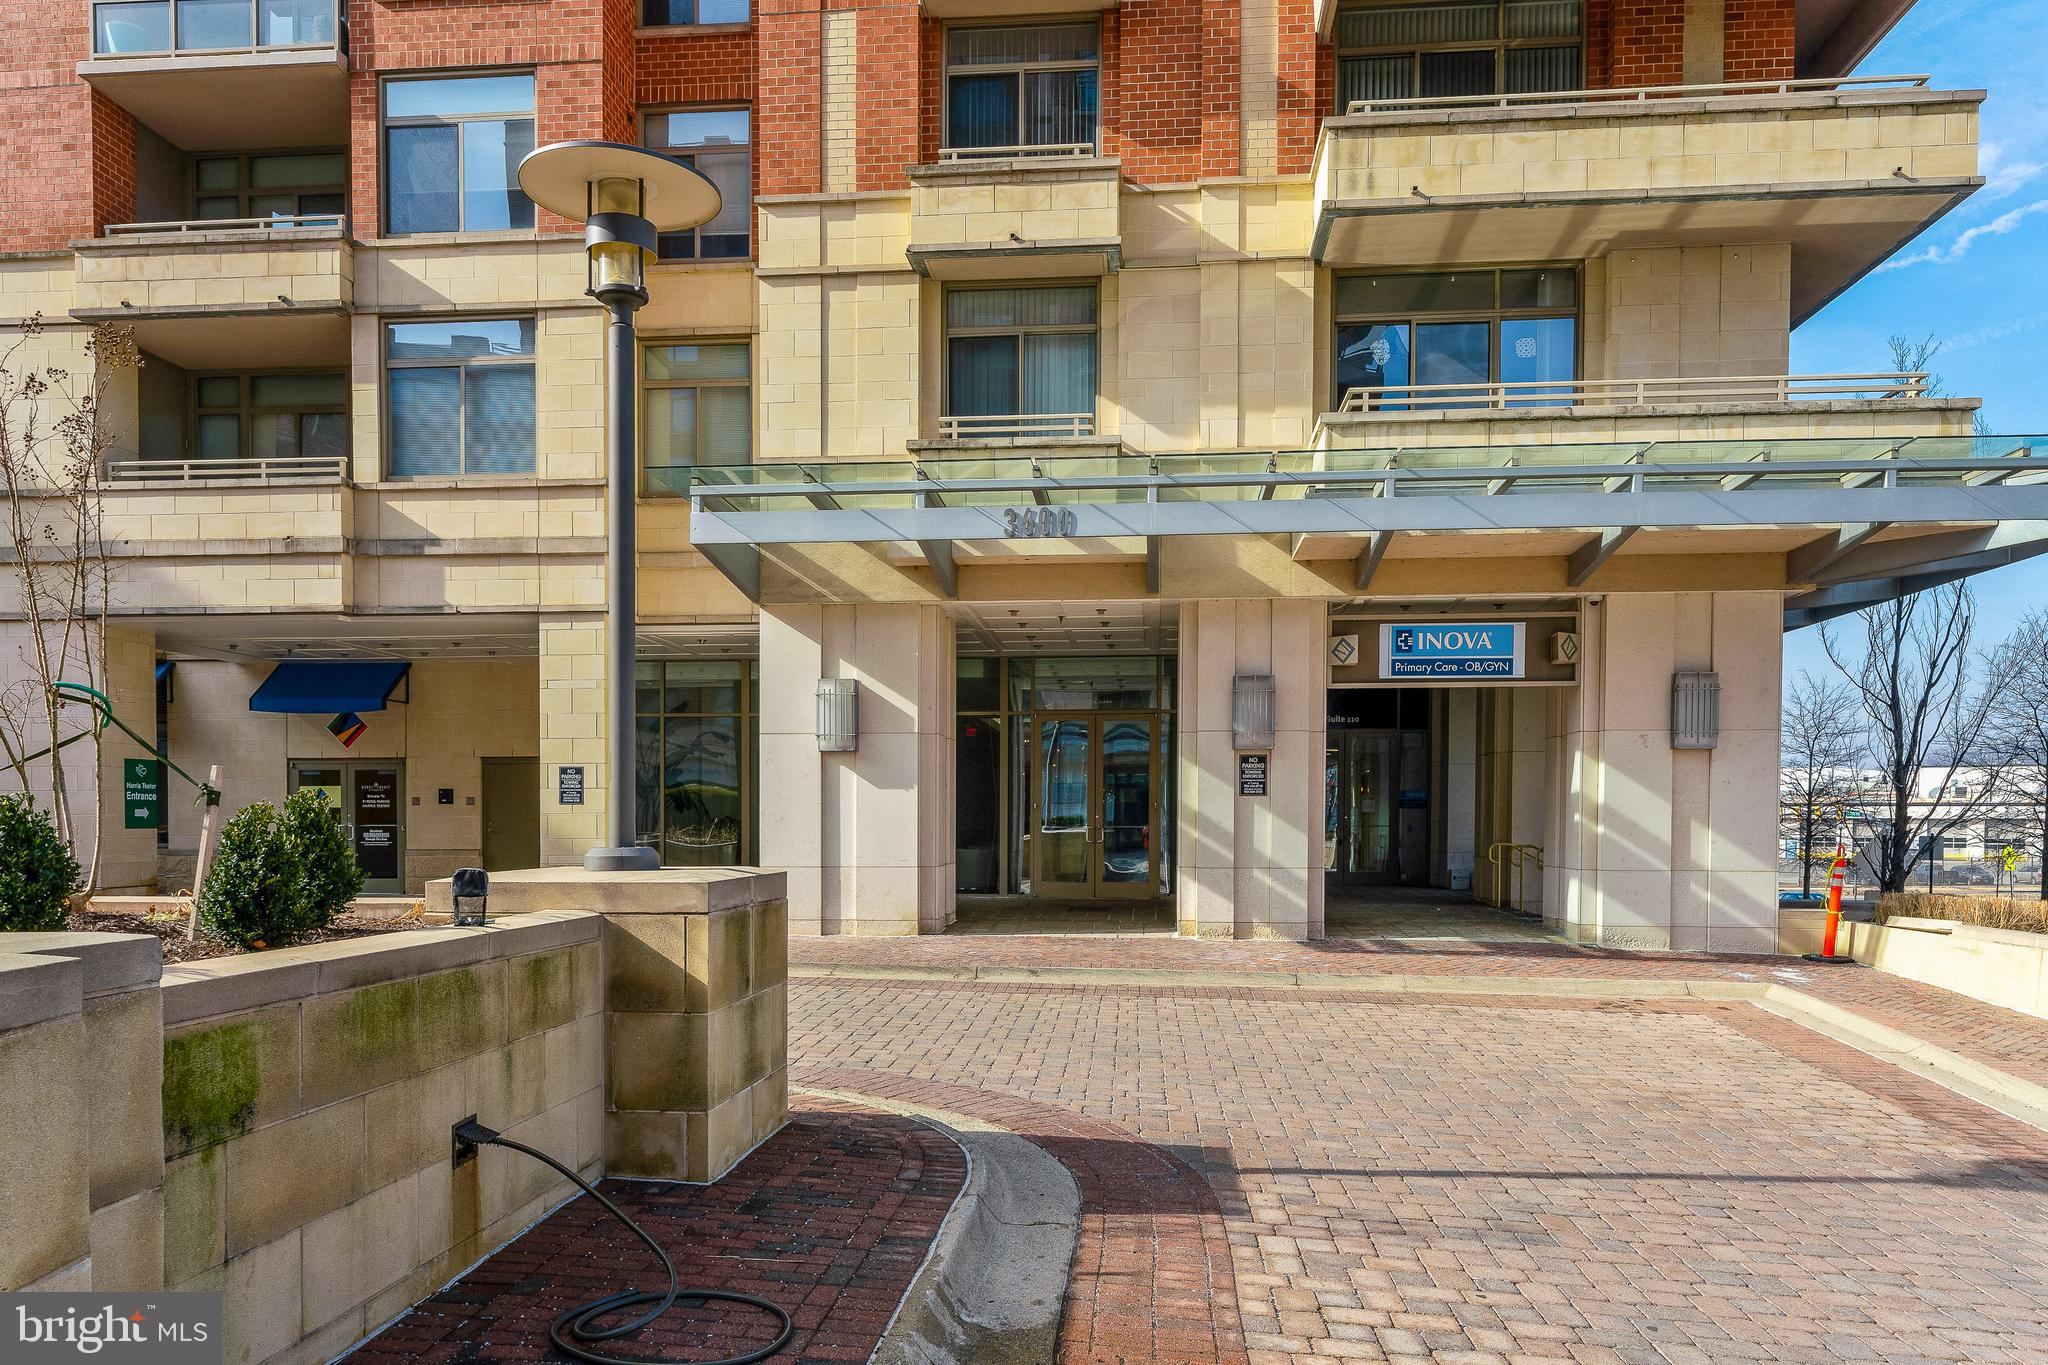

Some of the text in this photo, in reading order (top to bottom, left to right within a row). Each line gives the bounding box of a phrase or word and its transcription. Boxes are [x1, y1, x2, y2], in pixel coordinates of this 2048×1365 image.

[1003, 507, 1072, 538] 3600
[1417, 631, 1492, 650] INOVA
[1395, 662, 1432, 674] Primary
[1434, 661, 1457, 672] Care
[1465, 660, 1509, 673] OB/GYN
[1327, 715, 1345, 723] Suite
[142, 782, 157, 790] Teeter
[126, 791, 157, 801] Entrance
